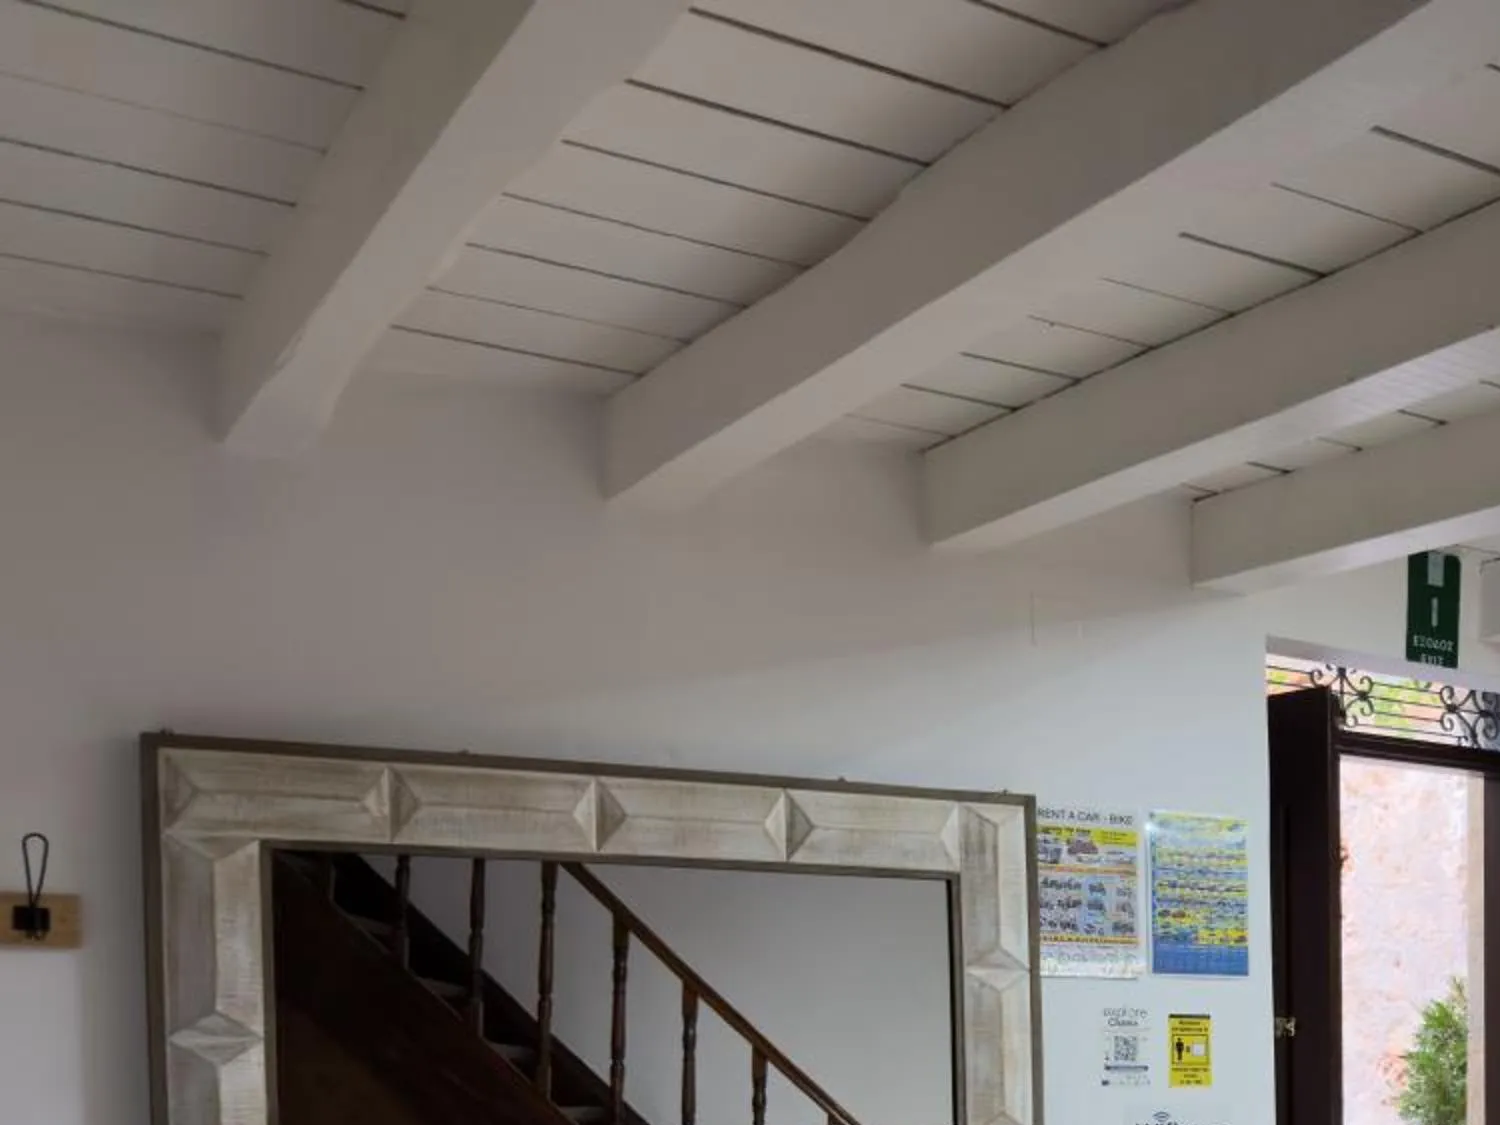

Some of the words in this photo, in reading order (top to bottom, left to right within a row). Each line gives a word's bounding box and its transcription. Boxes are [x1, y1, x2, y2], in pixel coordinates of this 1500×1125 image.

[1037, 808, 1067, 821] RENT
[1068, 810, 1076, 821] A
[1077, 811, 1101, 823] CAR
[1109, 814, 1134, 826] BIKE
